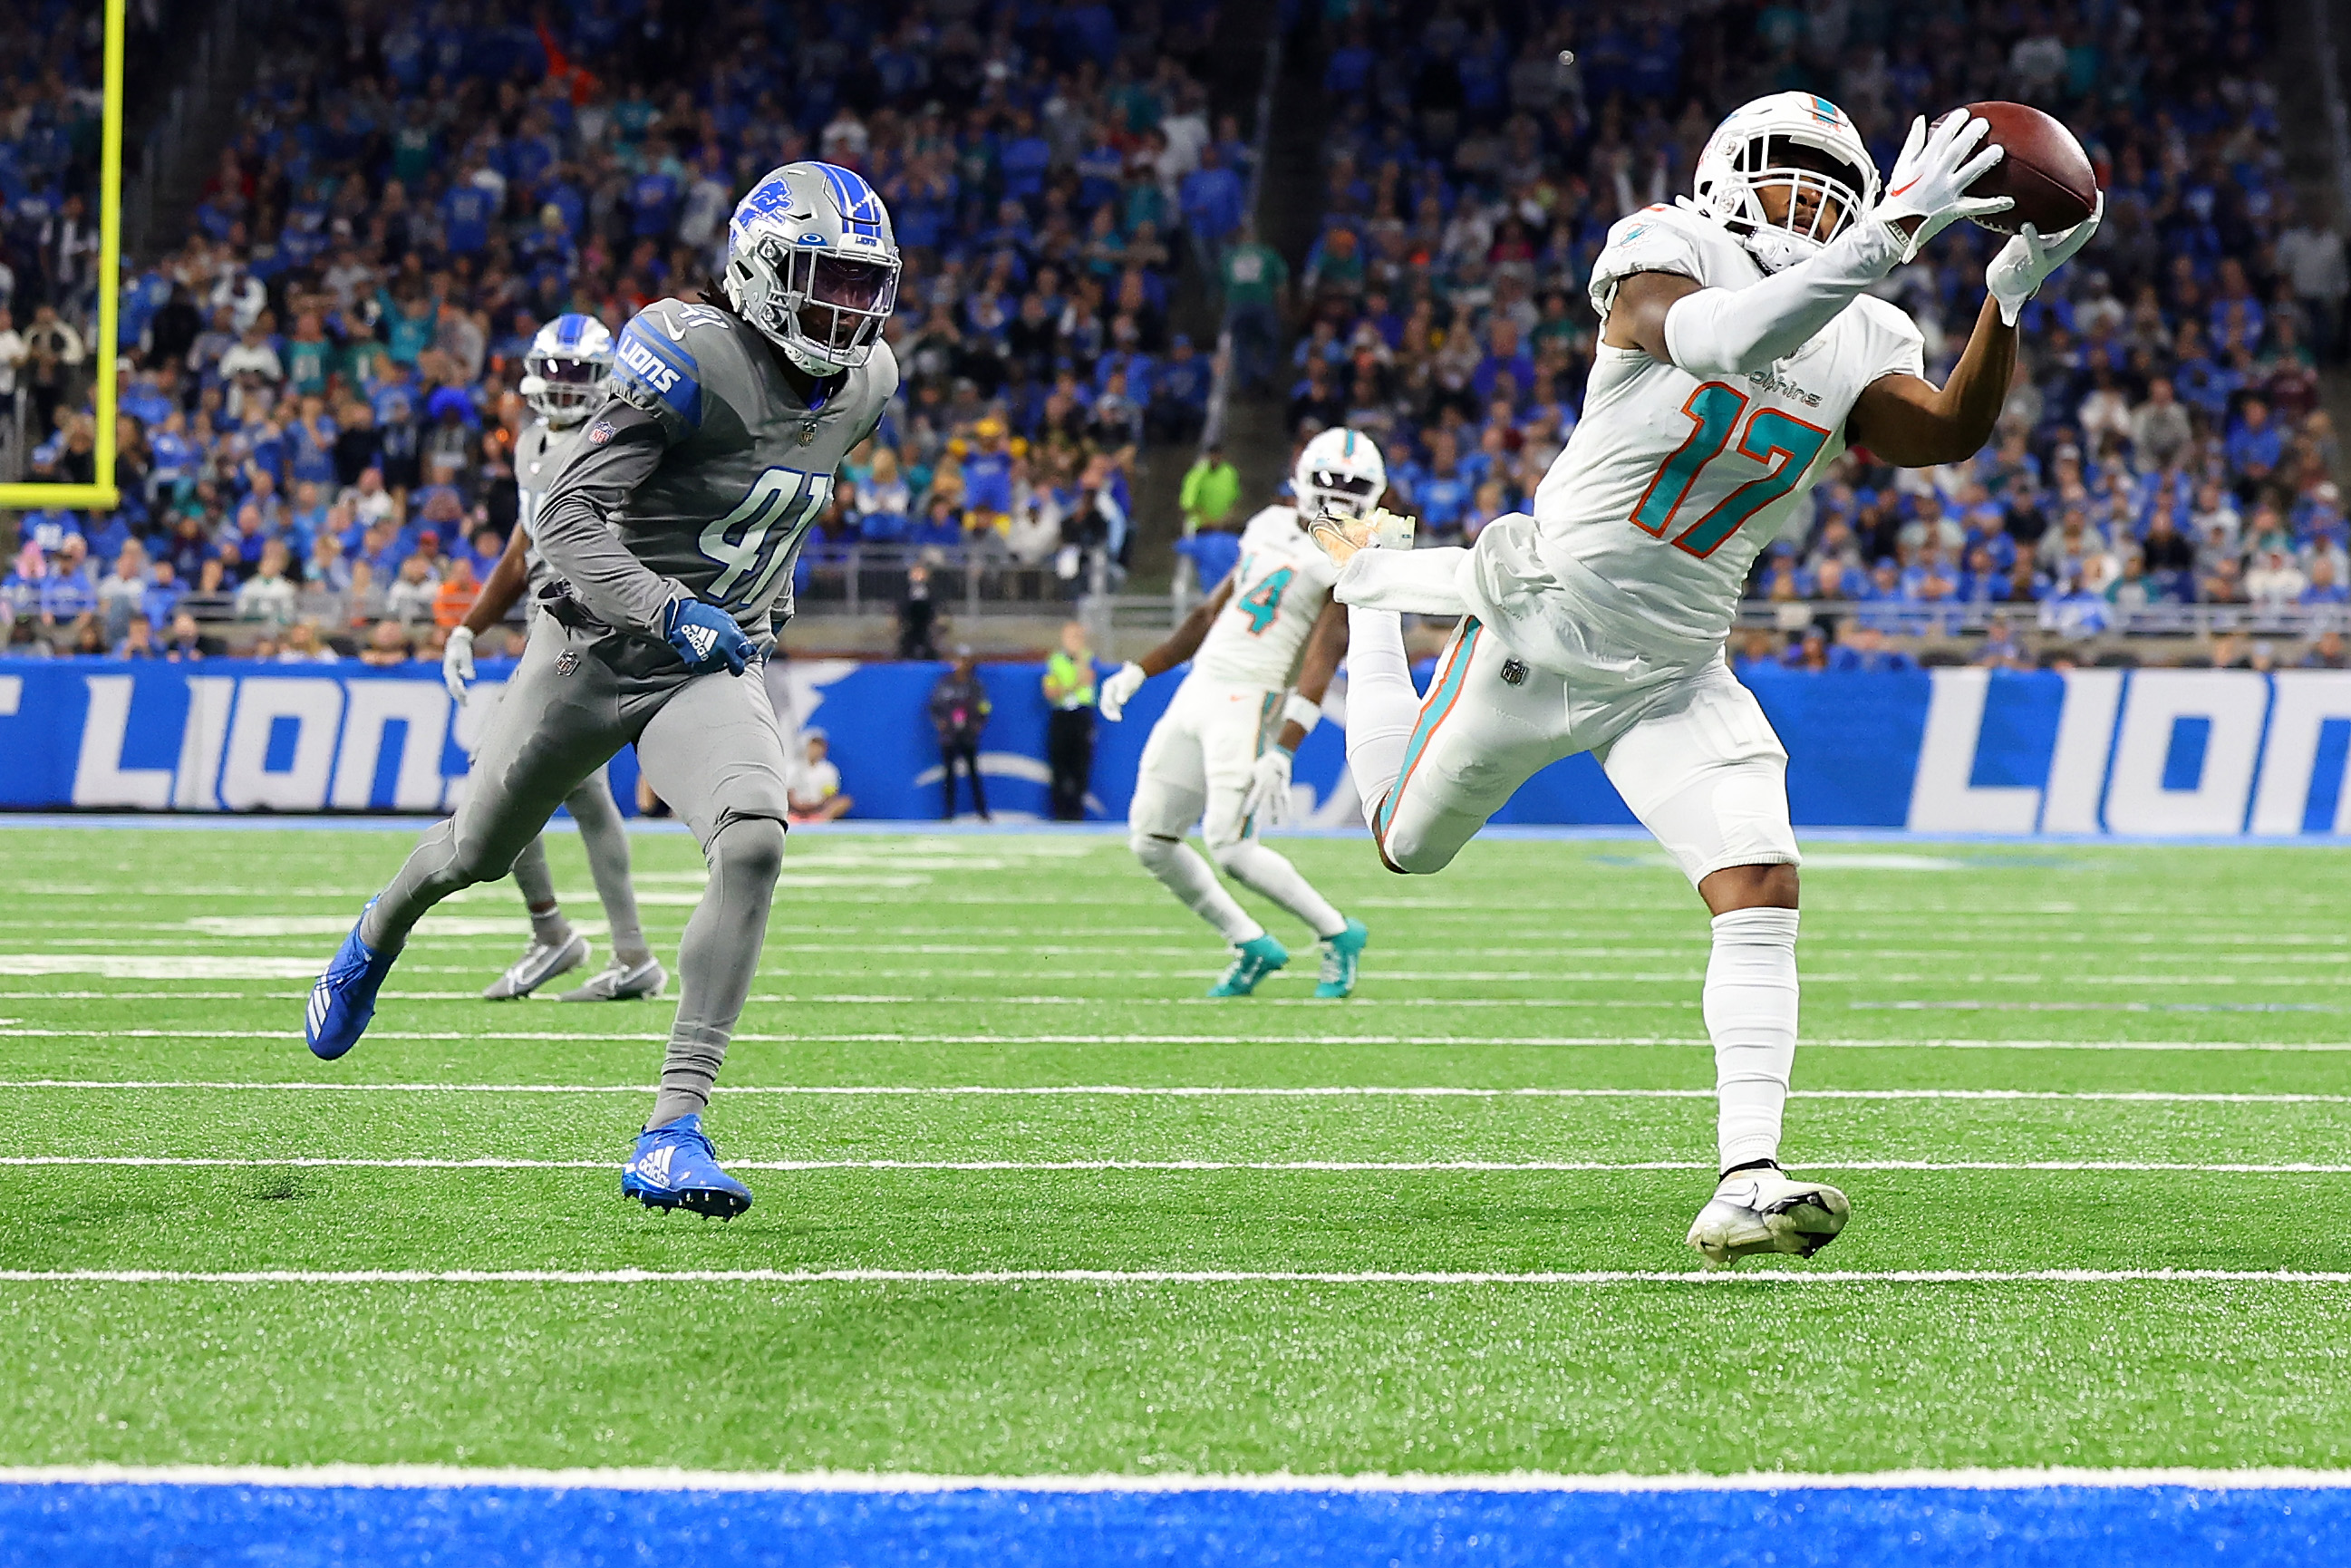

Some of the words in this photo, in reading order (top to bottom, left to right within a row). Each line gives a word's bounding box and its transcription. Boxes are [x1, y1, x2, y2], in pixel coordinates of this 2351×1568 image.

[619, 335, 681, 393] LIONS
[1744, 371, 1824, 408] olphins
[1628, 381, 1832, 559] 17
[698, 466, 831, 608] 41
[682, 624, 710, 662] adidas
[639, 1158, 671, 1188] adidas
